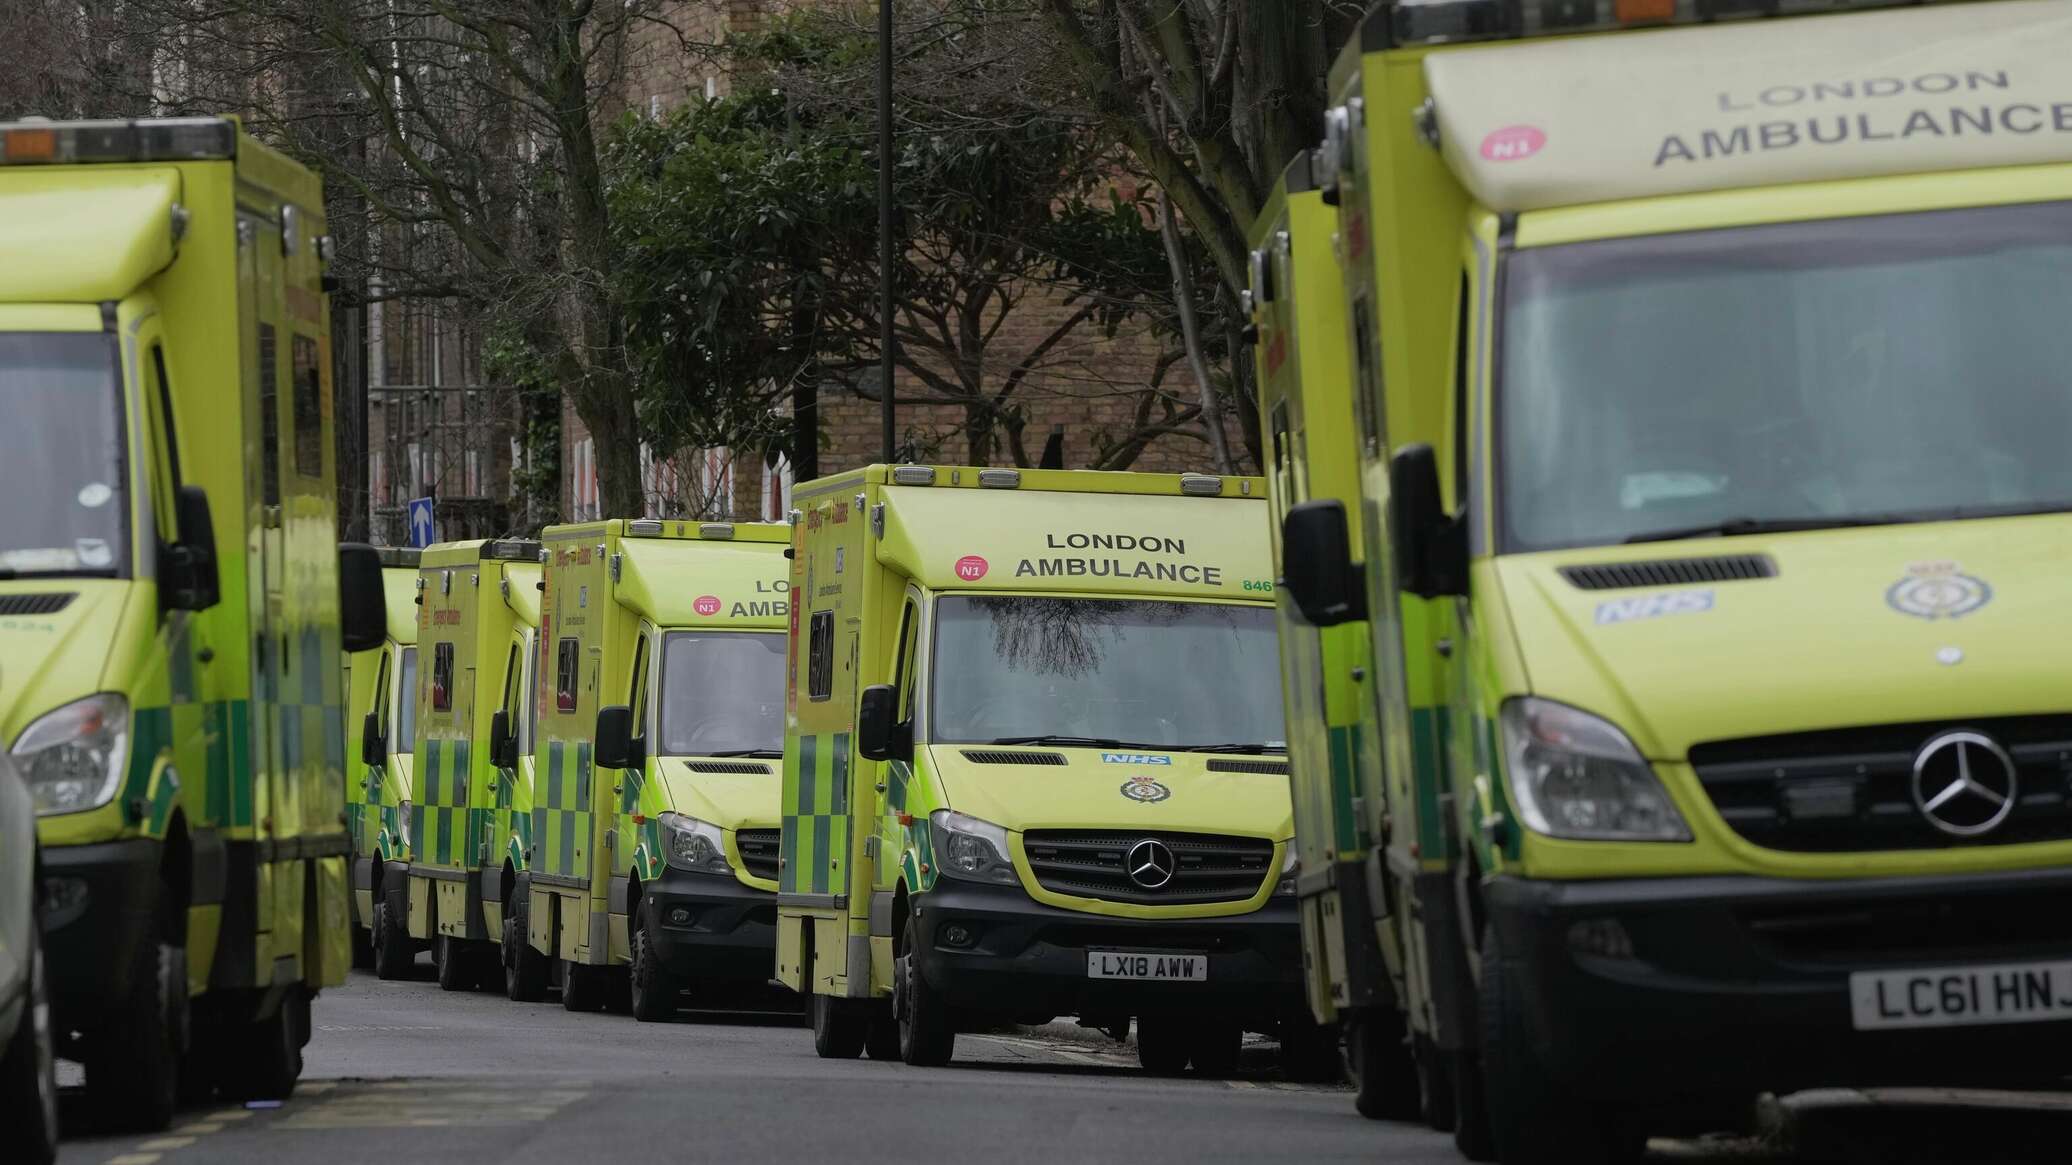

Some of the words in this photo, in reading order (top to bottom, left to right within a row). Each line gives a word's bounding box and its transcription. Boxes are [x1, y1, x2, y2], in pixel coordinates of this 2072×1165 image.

[1717, 70, 2010, 112] LONDON
[1652, 102, 2072, 170] AMBULANCE
[1046, 532, 1186, 555] LONDON
[961, 565, 980, 577] N1
[1015, 558, 1223, 586] AMBULANCE
[699, 603, 715, 613] N1
[1104, 754, 1168, 764] NHS
[1101, 955, 1149, 977] LX18
[1154, 957, 1195, 978] AWW
[1876, 974, 1981, 1019] LC61
